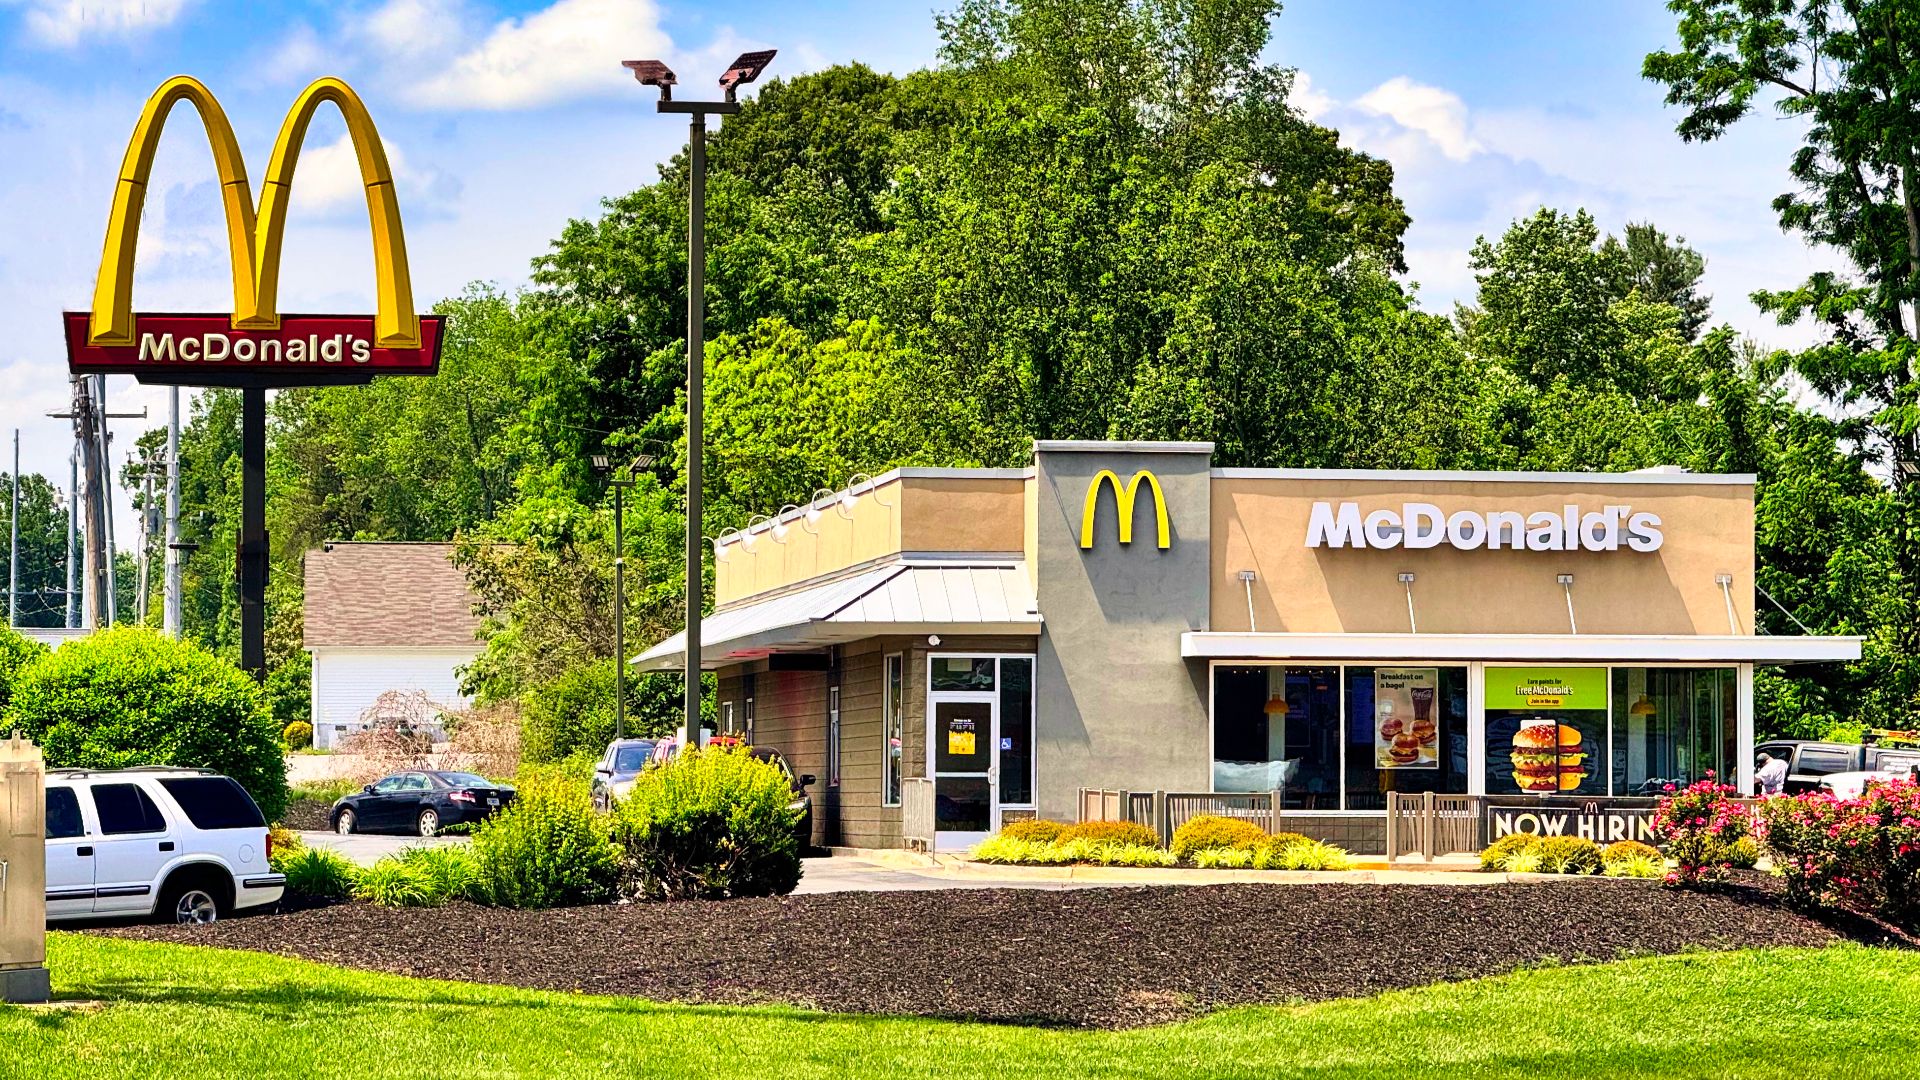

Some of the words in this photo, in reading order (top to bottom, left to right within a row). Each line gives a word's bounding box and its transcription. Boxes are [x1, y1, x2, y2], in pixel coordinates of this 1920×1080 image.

[138, 332, 371, 364] McDonald's
[1304, 501, 1665, 553] McDonald's
[1385, 682, 1405, 690] bagel
[1516, 685, 1532, 695] Free
[1532, 685, 1574, 695] McDonald's
[1495, 812, 1568, 838] NOW
[1577, 814, 1663, 842] HIRIN
